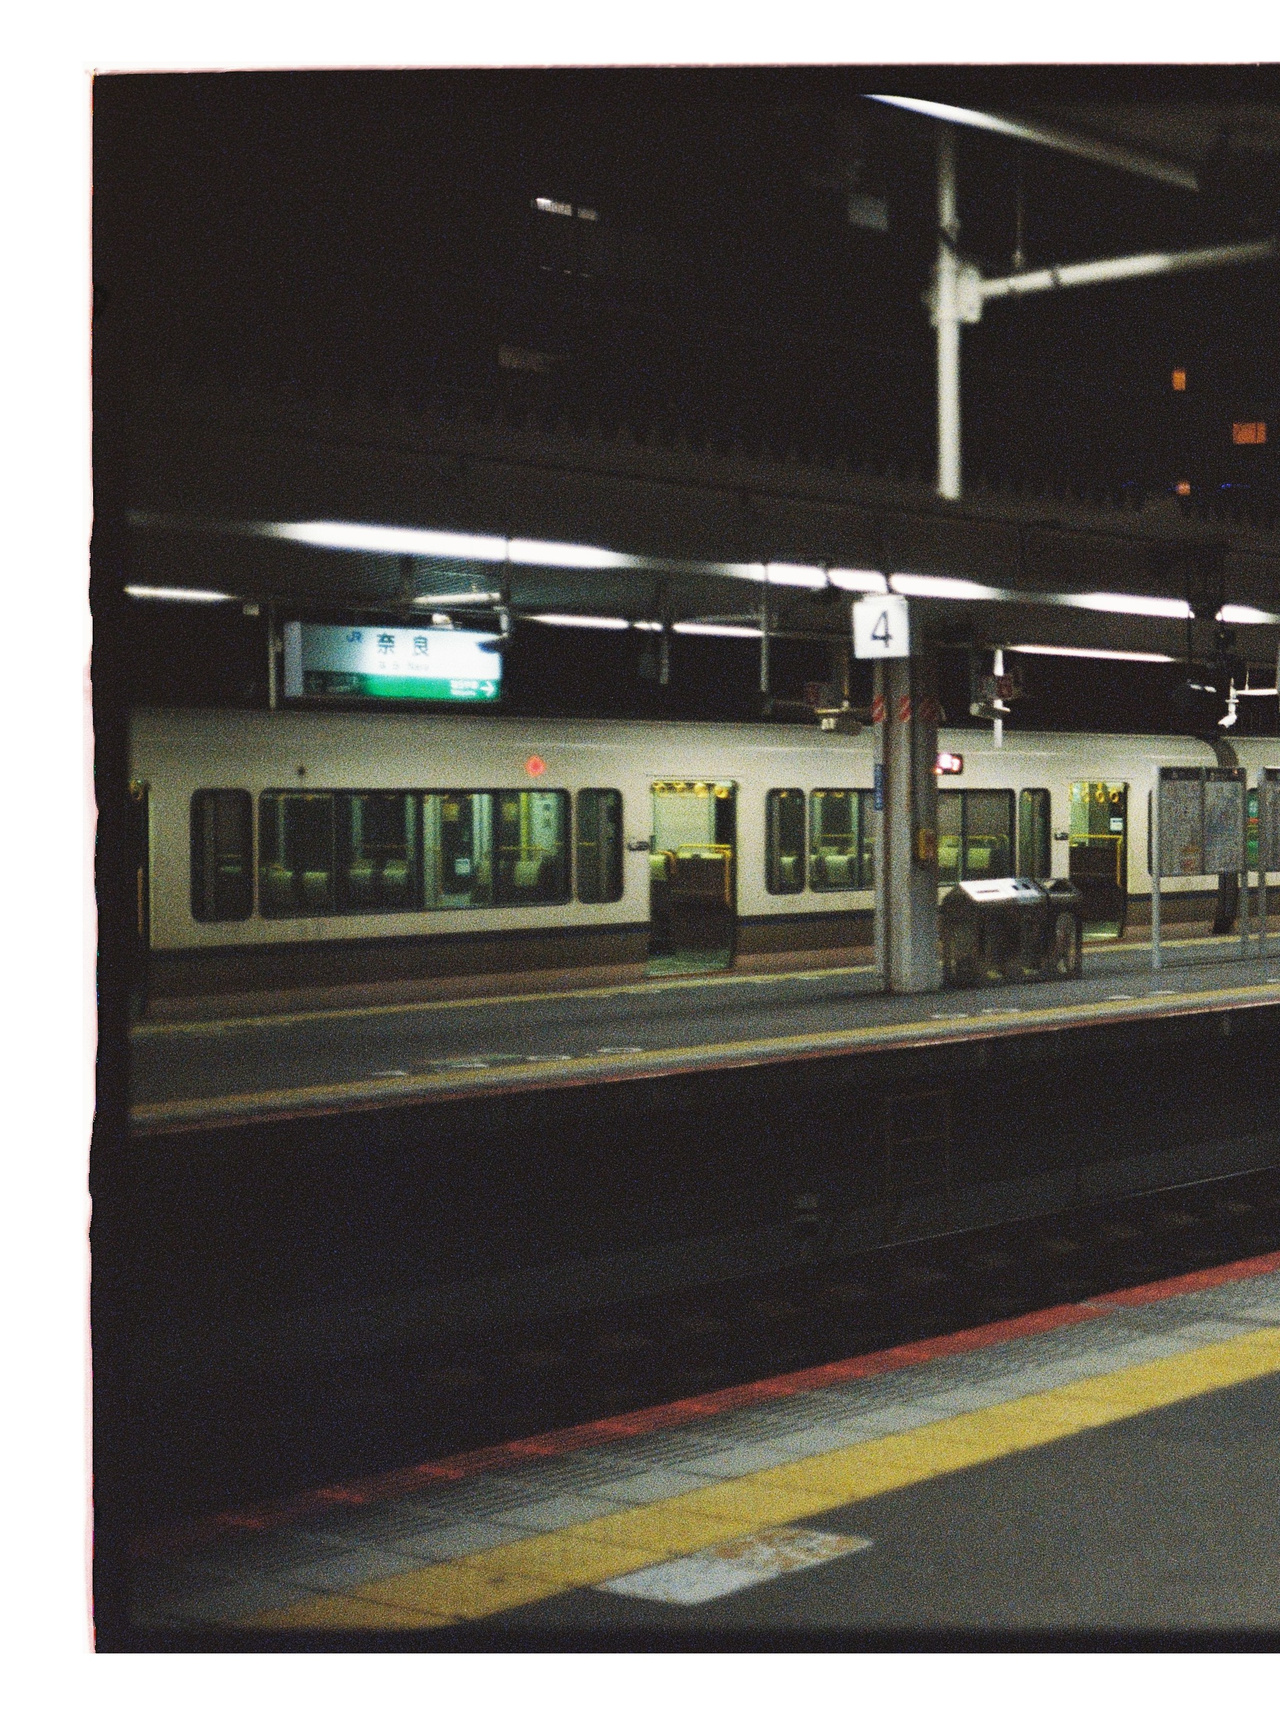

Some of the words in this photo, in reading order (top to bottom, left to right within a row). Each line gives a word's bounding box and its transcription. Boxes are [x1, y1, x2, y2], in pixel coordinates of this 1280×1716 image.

[346, 631, 362, 644] JR
[376, 632, 429, 656] 奈良
[871, 610, 893, 648] 4
